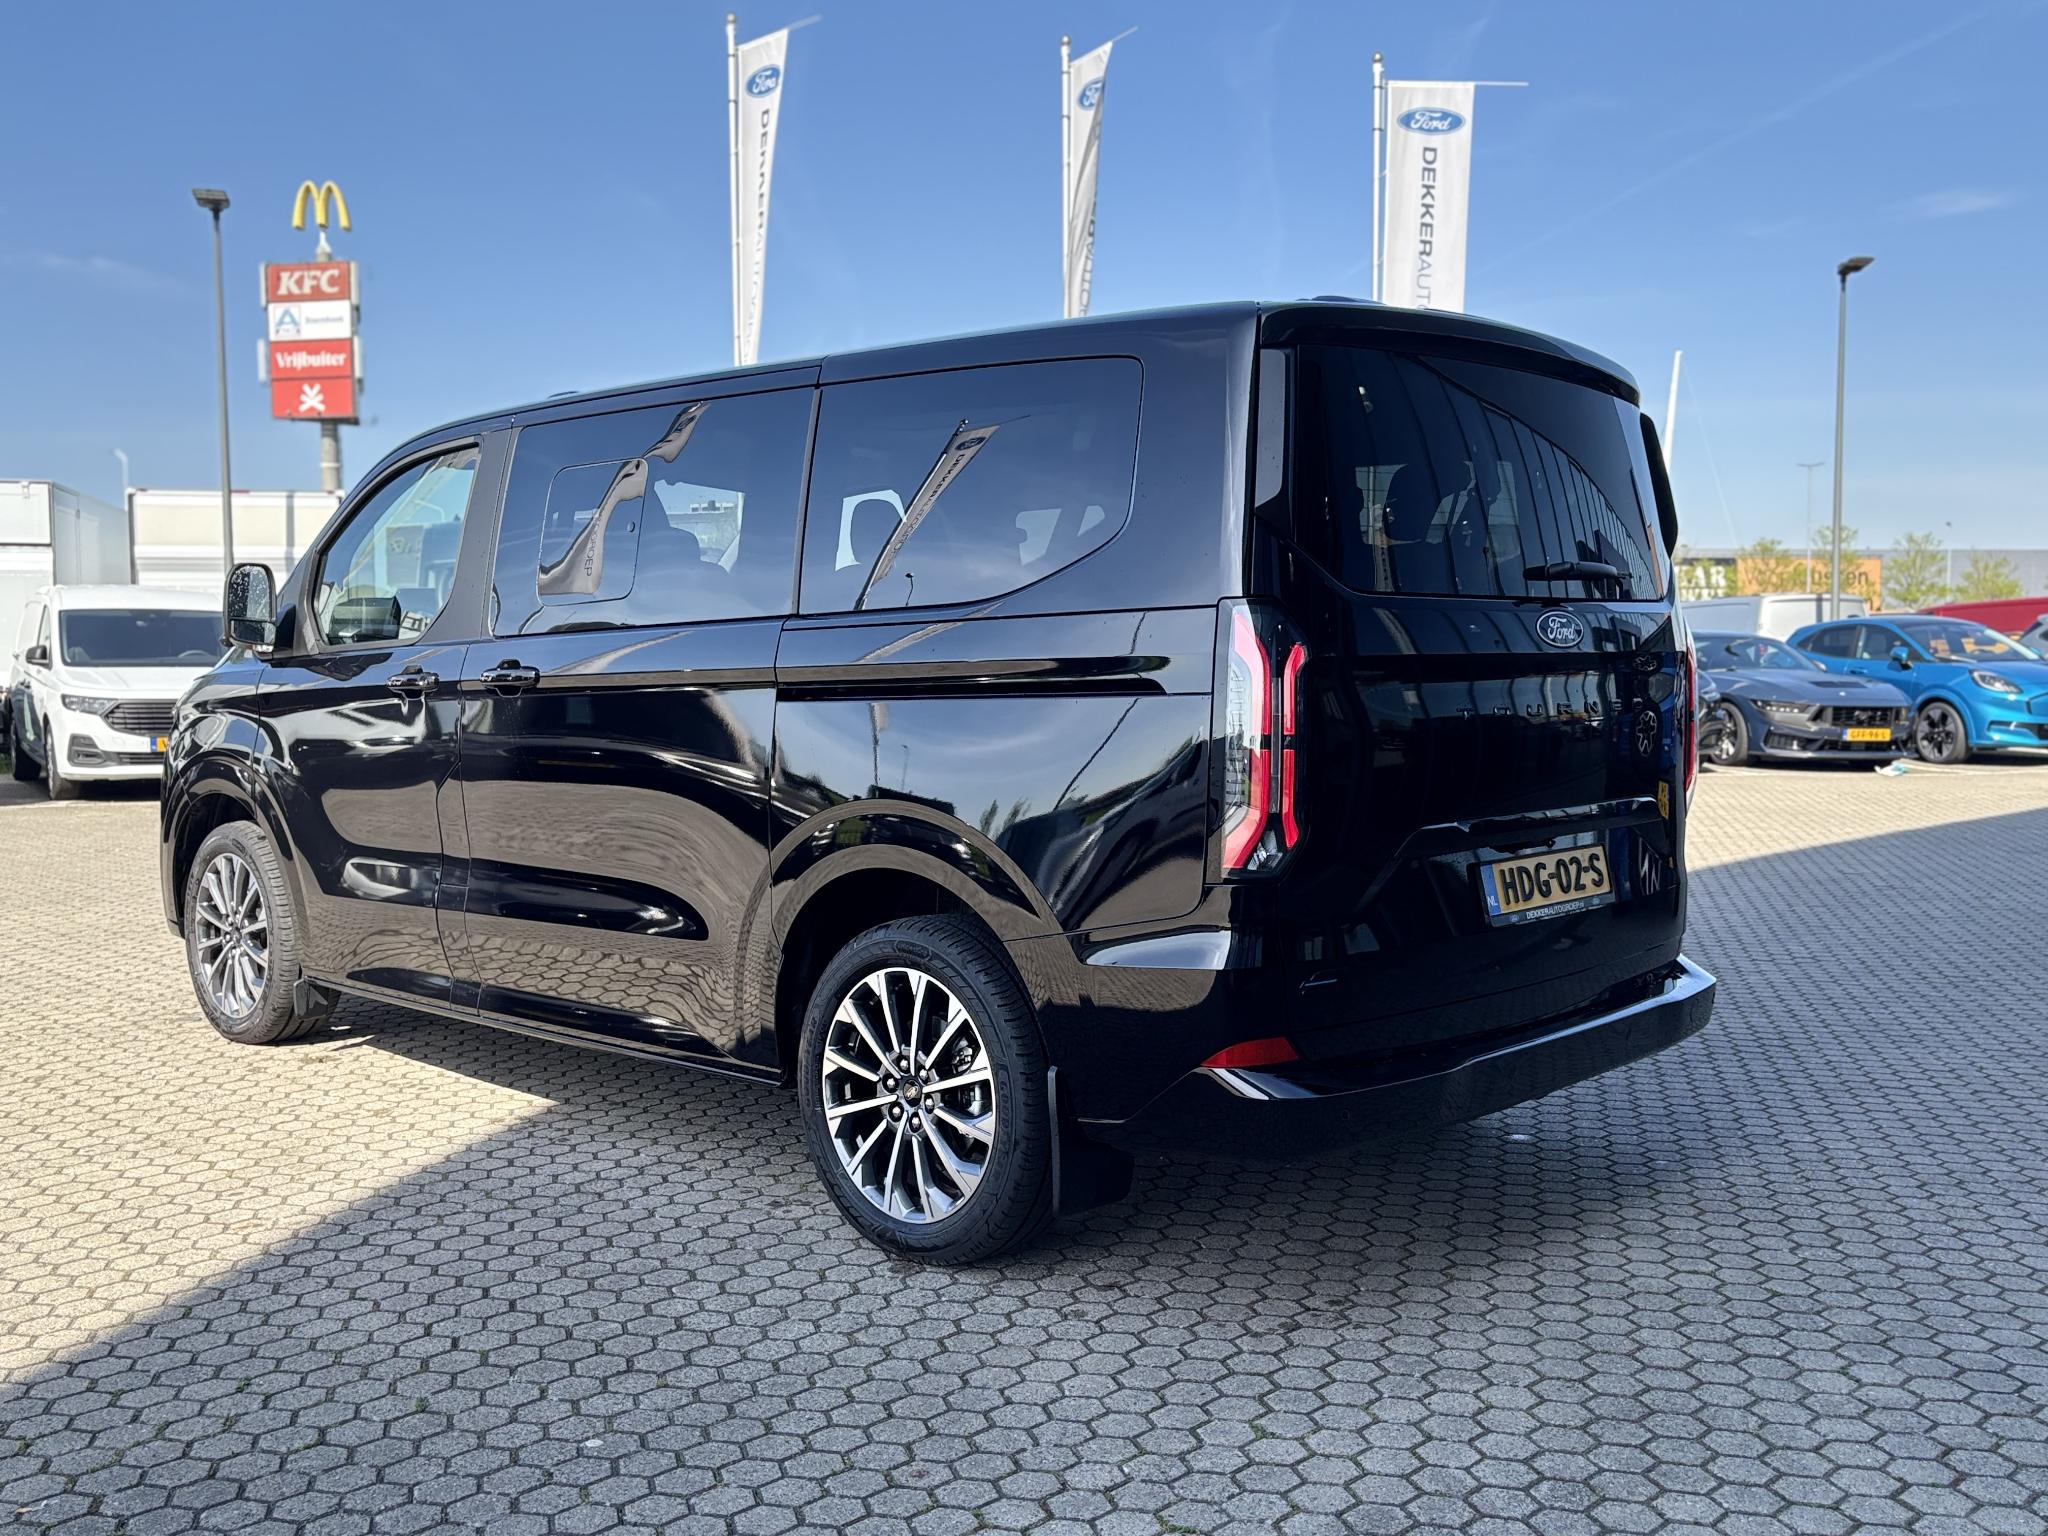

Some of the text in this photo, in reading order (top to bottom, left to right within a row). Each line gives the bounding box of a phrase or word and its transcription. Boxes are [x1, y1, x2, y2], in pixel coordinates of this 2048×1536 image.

[276, 268, 341, 295] KFC
[274, 350, 348, 370] Vrijbuiter
[1499, 853, 1605, 906] HDG-02-S
[1487, 895, 1499, 907] NL
